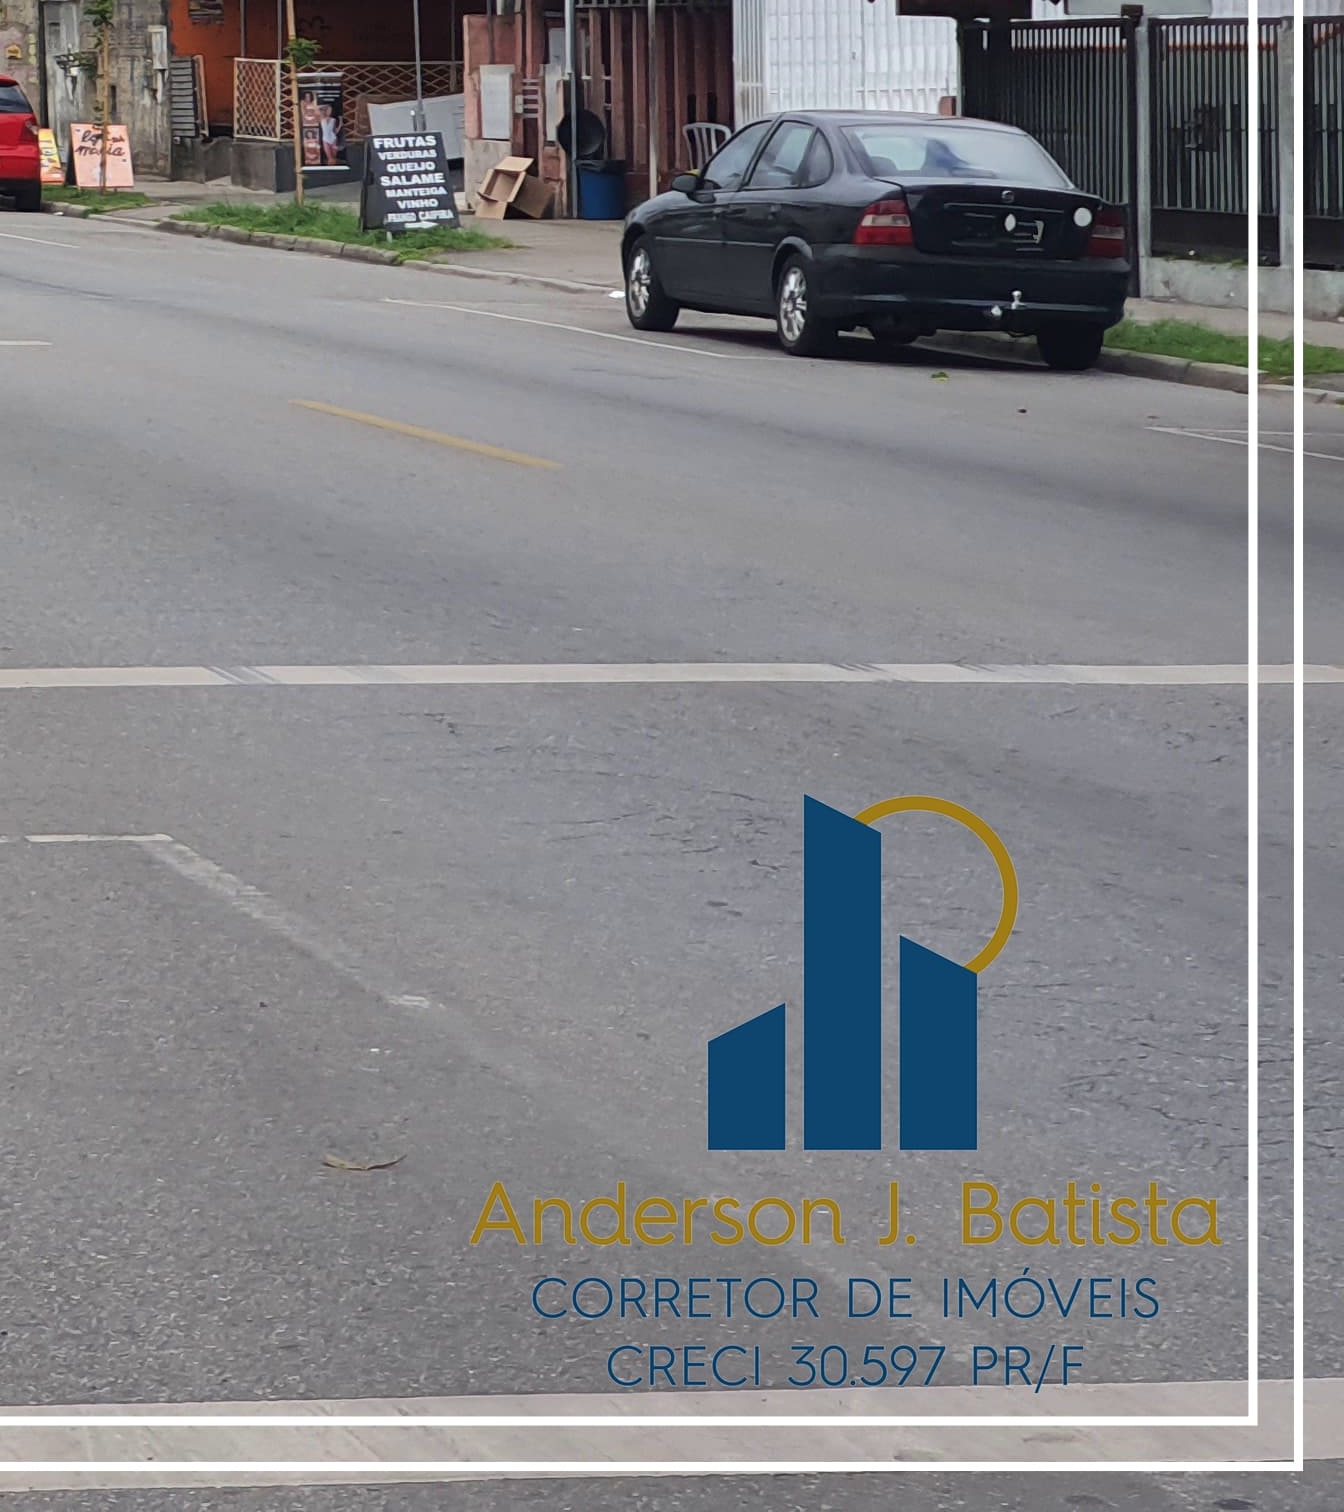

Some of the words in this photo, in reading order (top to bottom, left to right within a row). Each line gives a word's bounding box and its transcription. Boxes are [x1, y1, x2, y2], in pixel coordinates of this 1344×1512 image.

[373, 135, 437, 149] FRUTAS
[377, 149, 438, 161] VERDURAS
[386, 161, 436, 173] QUEIJO
[380, 172, 446, 187] SALAME
[385, 186, 448, 198] MANTEIGA
[396, 198, 439, 209] VINHO
